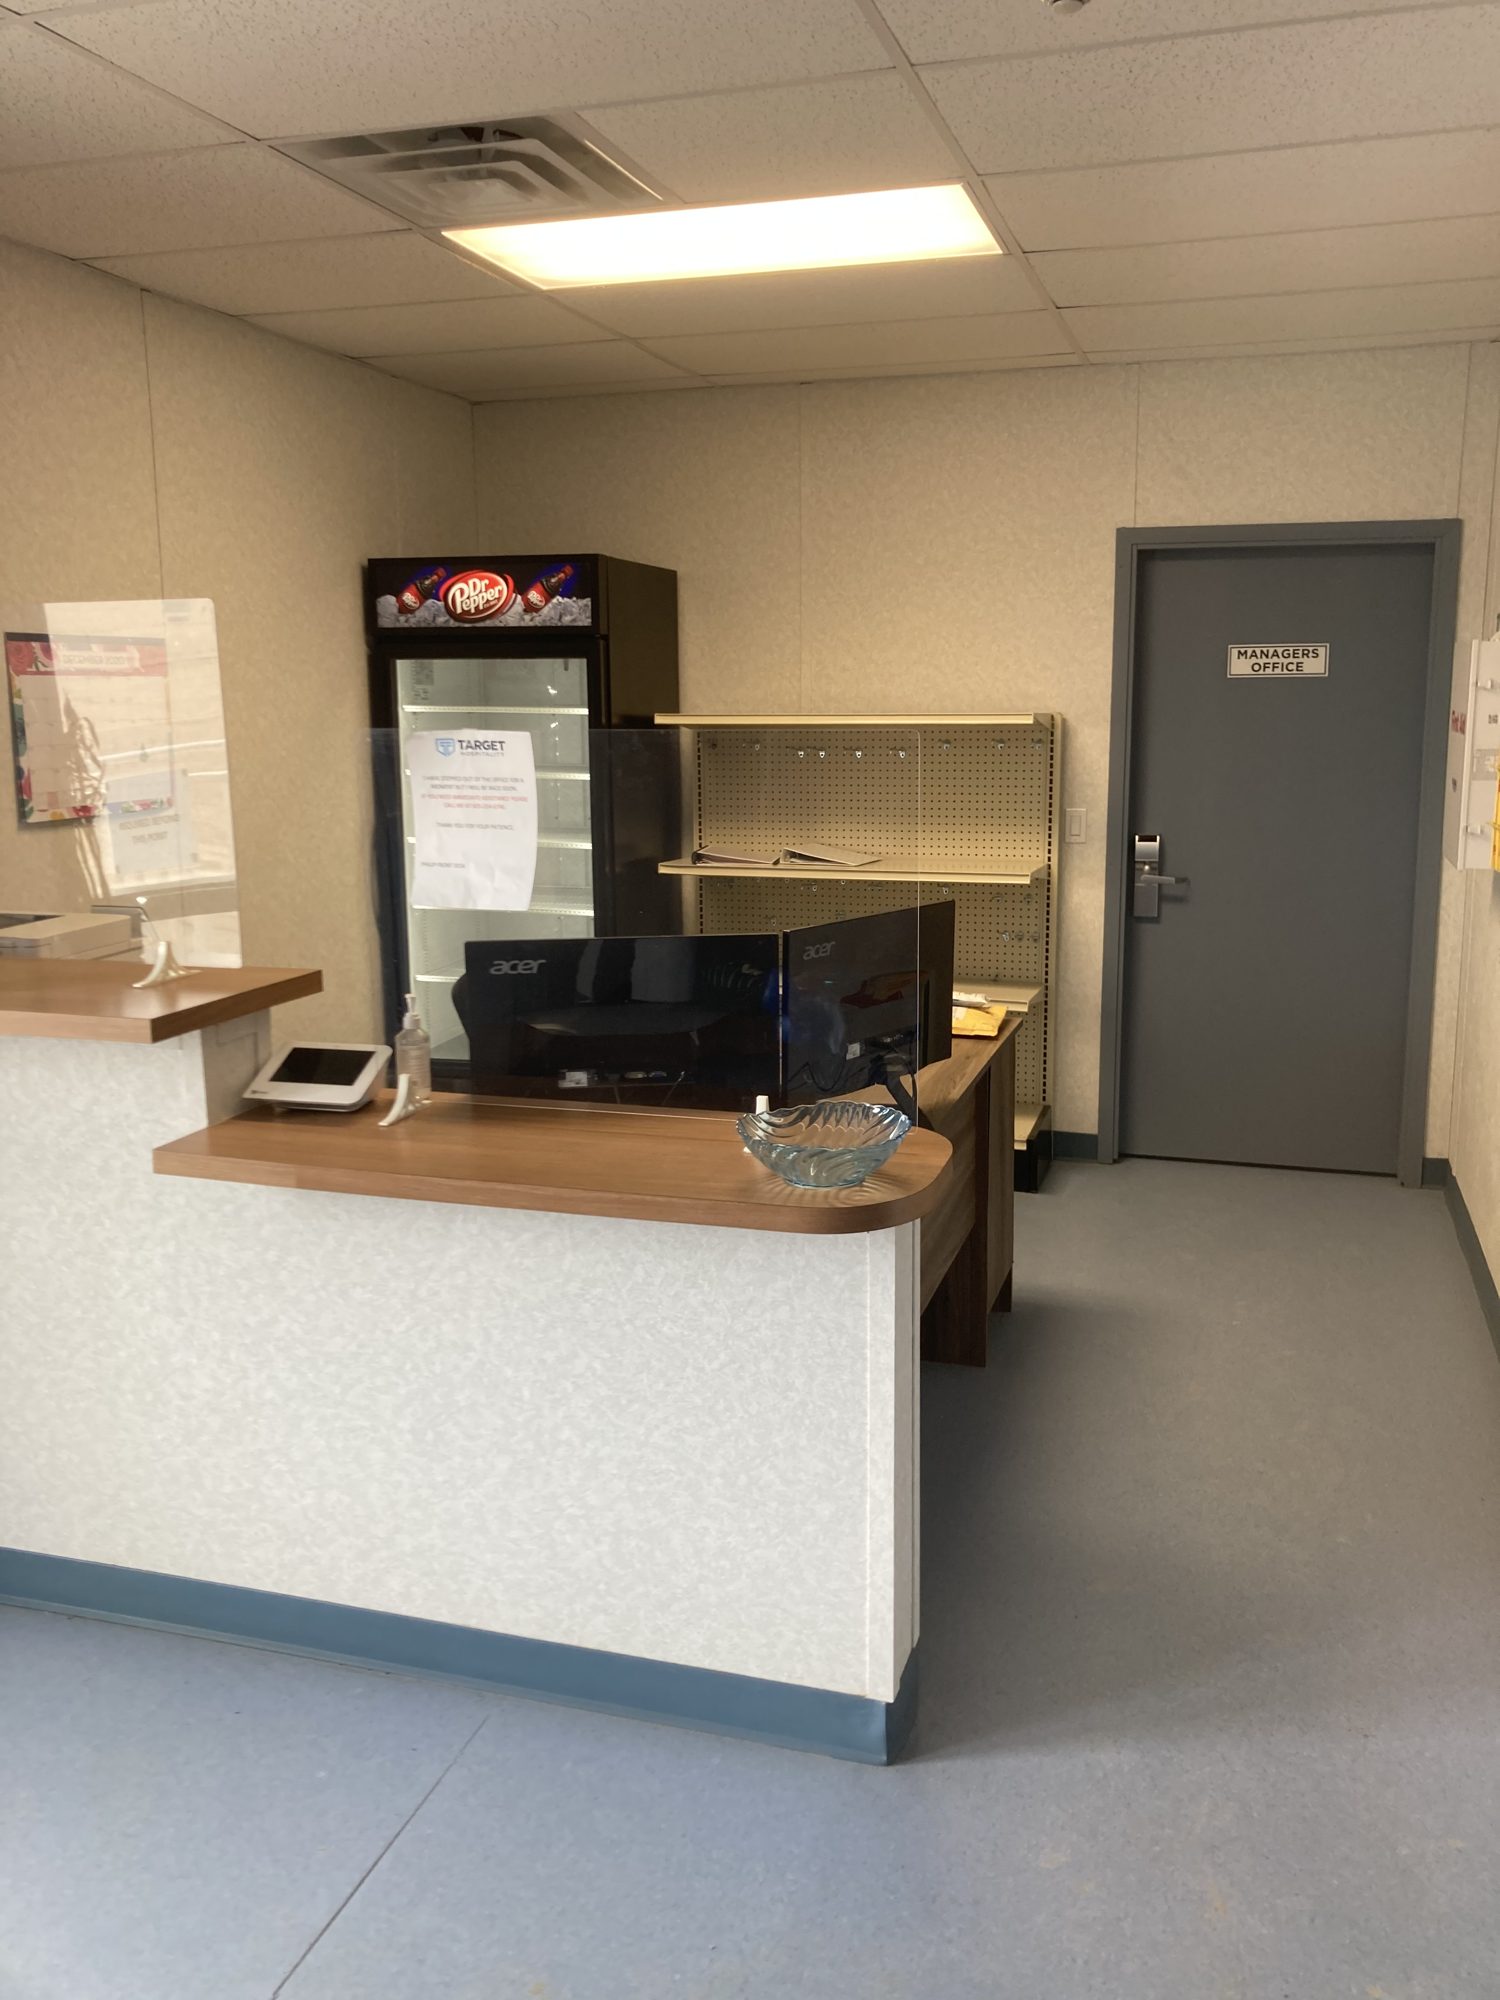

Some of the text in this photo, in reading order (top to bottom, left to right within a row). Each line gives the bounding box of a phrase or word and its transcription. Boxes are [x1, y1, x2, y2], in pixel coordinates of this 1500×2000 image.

[468, 578, 489, 597] Dr
[448, 582, 503, 615] Pepper
[1237, 648, 1320, 660] MANAGERS
[1251, 661, 1304, 673] OFFICE
[457, 739, 506, 751] TARGET
[803, 941, 836, 960] acer
[490, 960, 547, 975] acer
